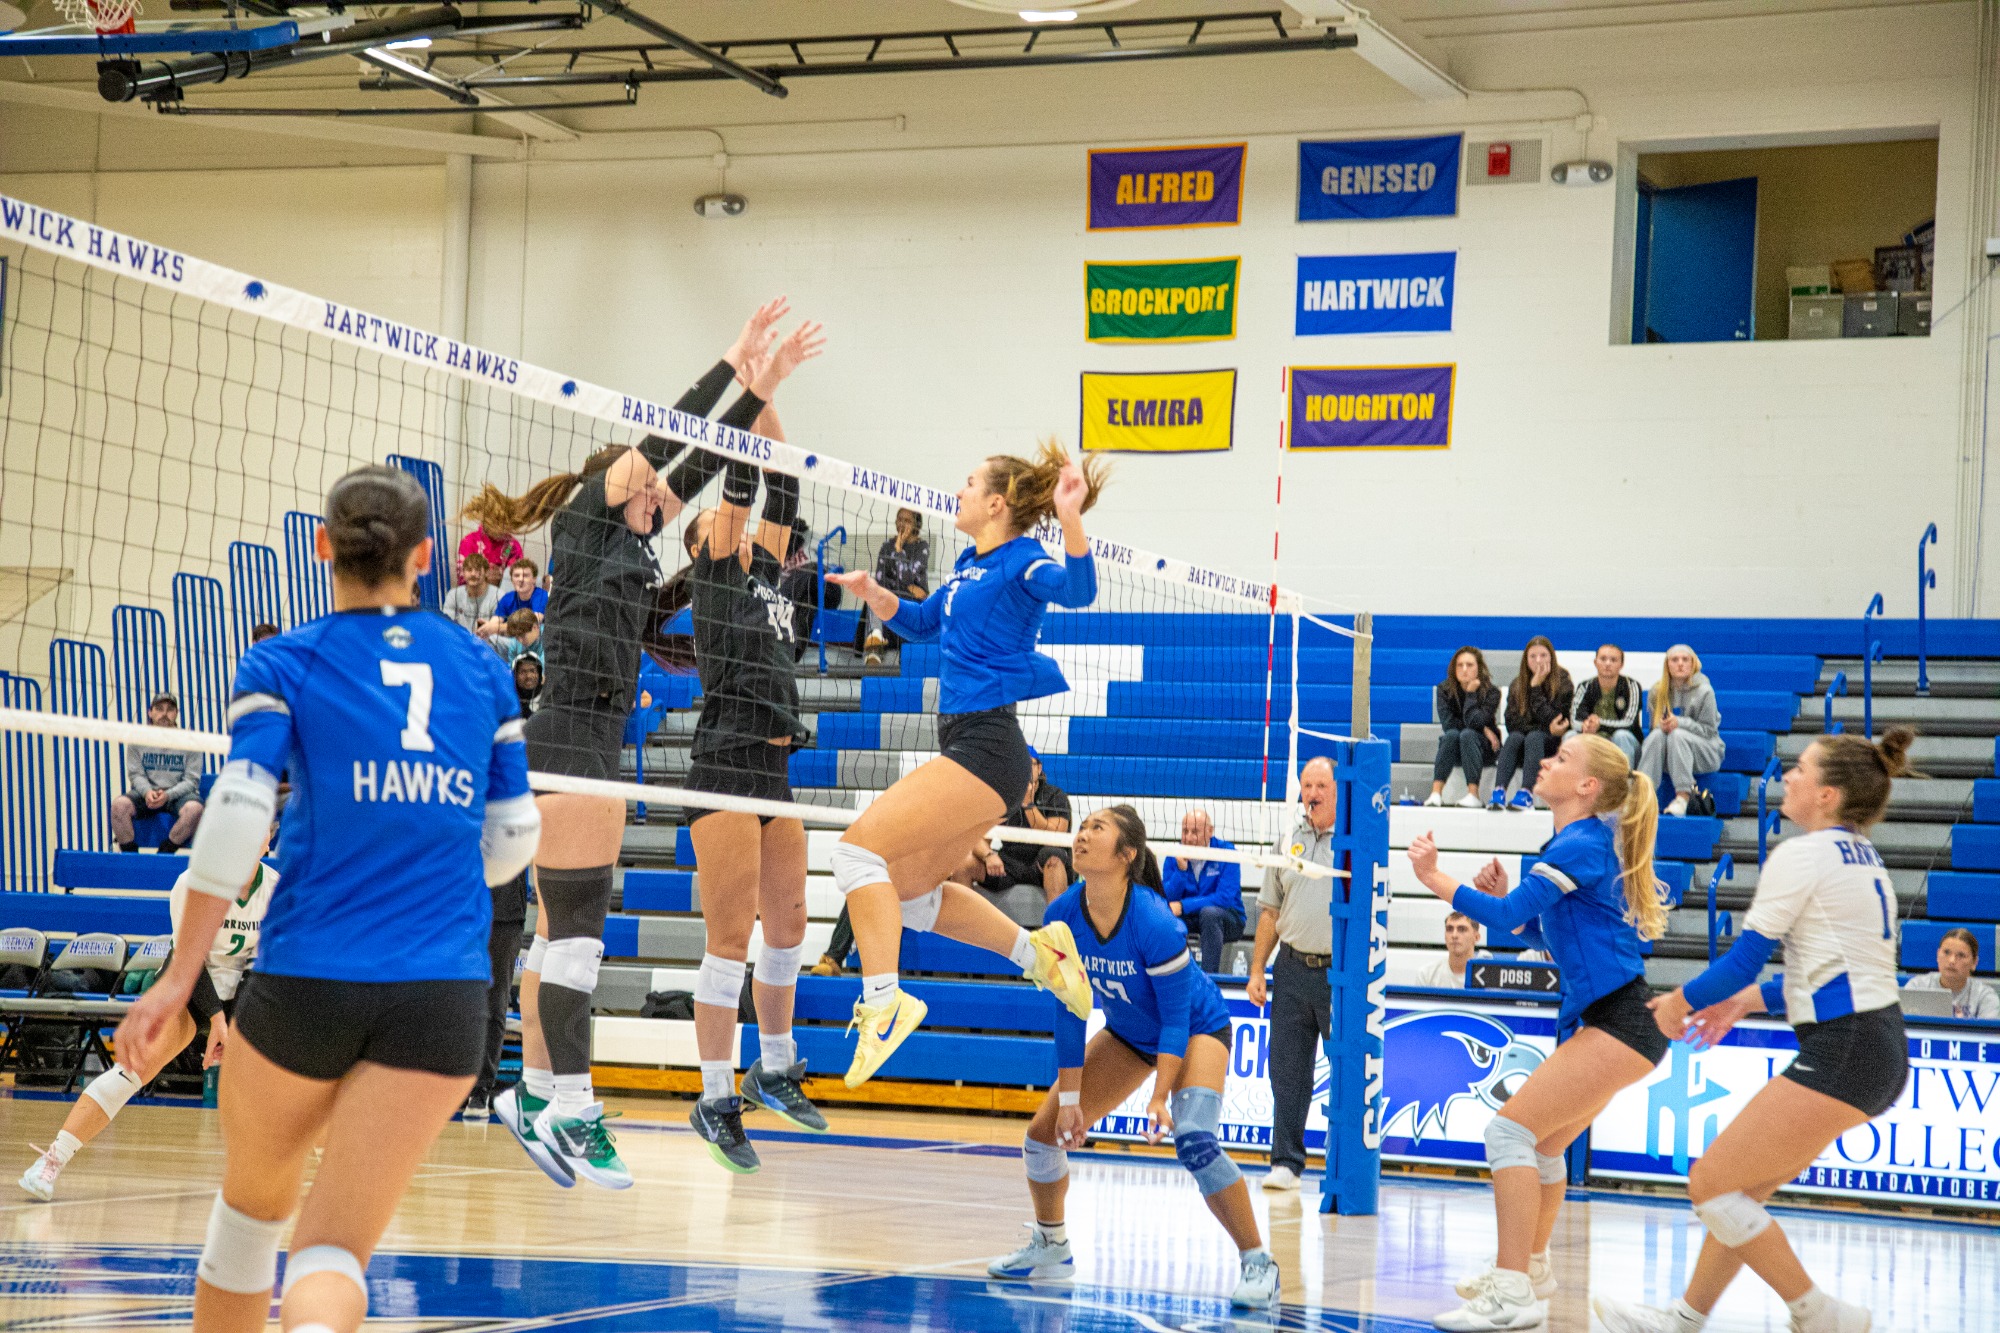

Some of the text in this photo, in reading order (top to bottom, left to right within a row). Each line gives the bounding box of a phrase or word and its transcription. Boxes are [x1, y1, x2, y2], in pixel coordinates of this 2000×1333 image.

[1116, 170, 1214, 205] ALFRED
[1321, 162, 1436, 195] GENESEO
[88, 227, 184, 282] HAWKS
[1091, 283, 1229, 316] BROCKPORT
[1303, 276, 1445, 311] HARTWICK
[324, 303, 519, 384] HARTWICK HAWKS
[1107, 397, 1204, 427] ELMIRA
[1306, 393, 1435, 422] HOUGHTON
[622, 396, 772, 461] HARTWICK HAWKS
[852, 466, 961, 516] HARTWICK HAWK
[1095, 539, 1134, 566] HAWKS
[1187, 566, 1271, 602] HARTWICK HAWKS
[379, 659, 434, 752] 7
[142, 752, 185, 765] HARTWICK
[352, 760, 475, 808] HAWKS
[1874, 878, 1891, 940] 1
[69, 941, 116, 955] HARTWICK
[1080, 955, 1137, 977] ARTWICK
[1362, 861, 1389, 1150] HAWKS
[1817, 1120, 2000, 1173] OLLE
